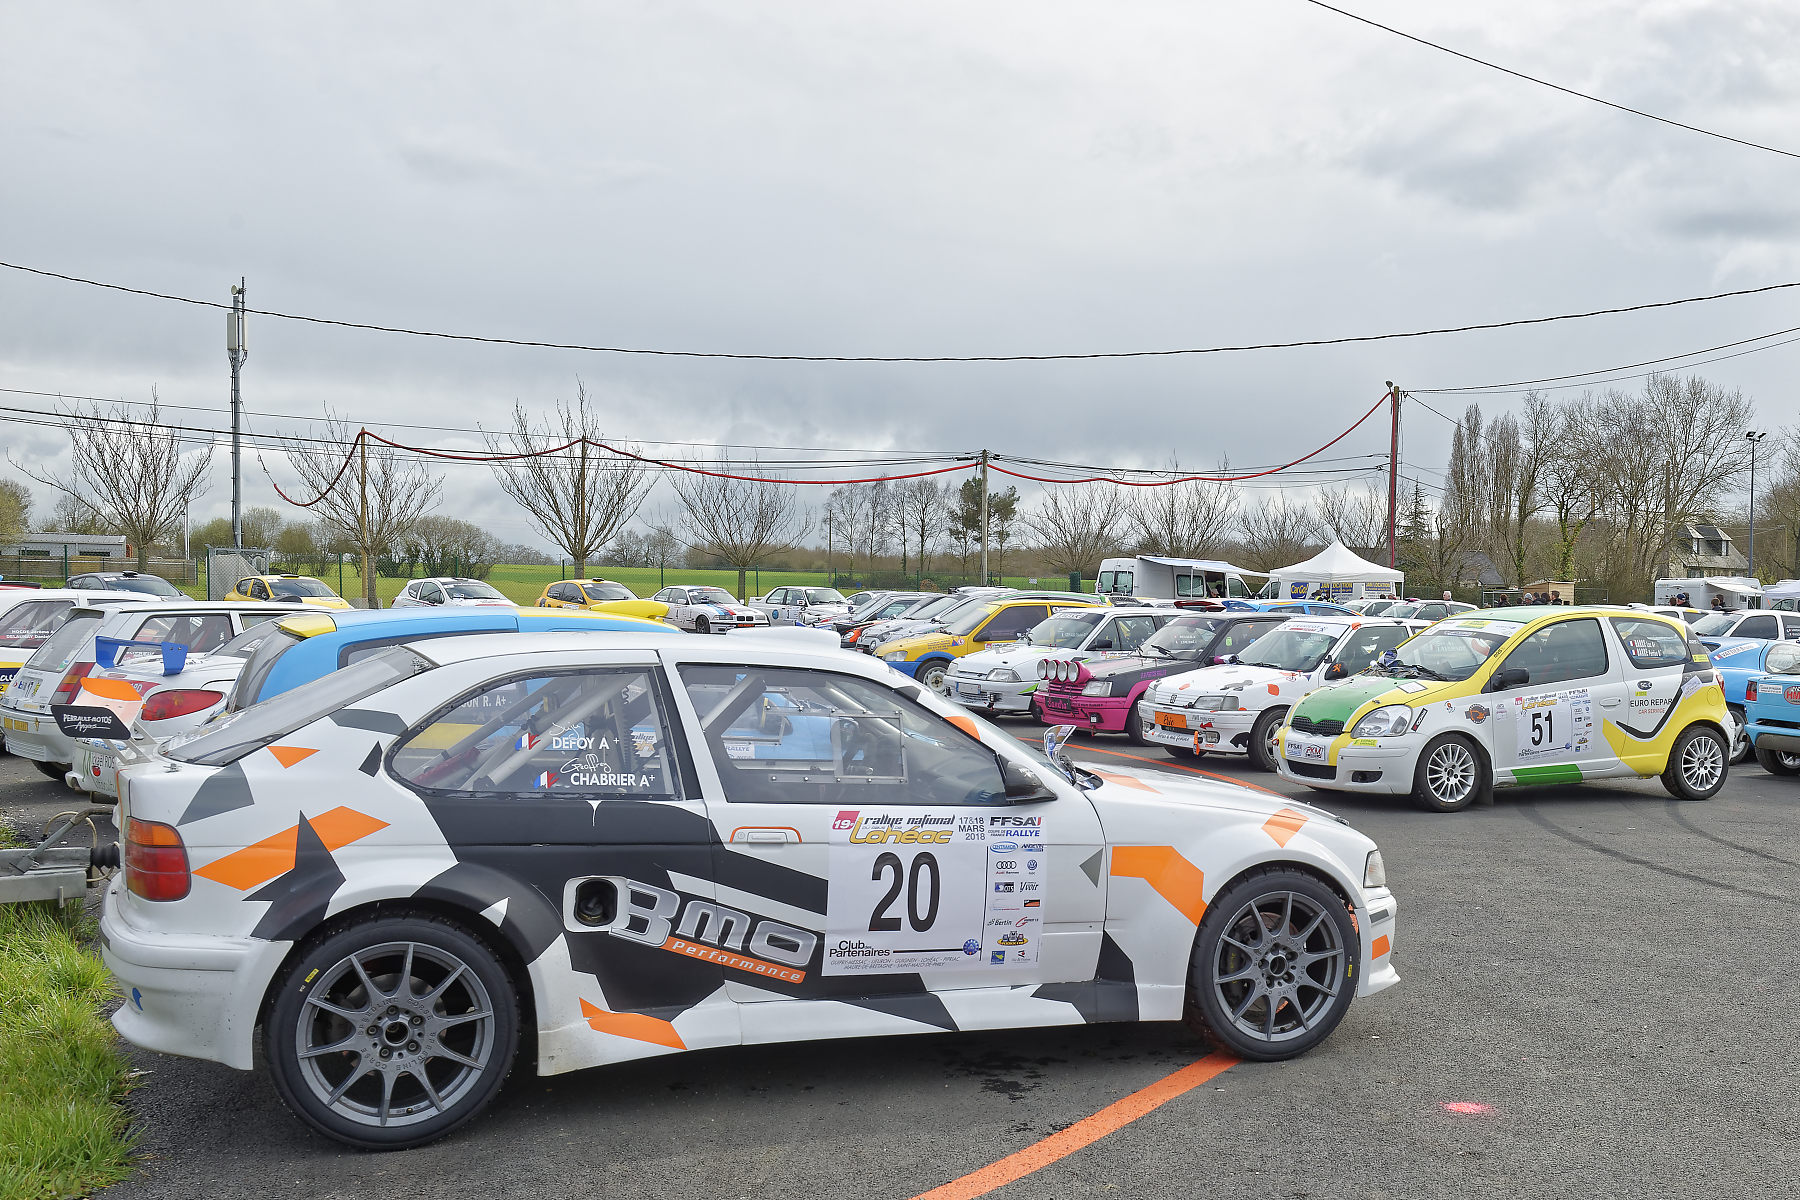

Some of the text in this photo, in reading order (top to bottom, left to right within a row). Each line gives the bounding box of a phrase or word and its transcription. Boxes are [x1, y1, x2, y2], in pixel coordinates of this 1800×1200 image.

[1630, 699, 1650, 708] EURO
[1531, 709, 1553, 747] 51
[552, 736, 595, 750] DEFOY
[570, 772, 637, 786] CHABRIER
[863, 813, 903, 828] rallye
[907, 813, 956, 828] national
[959, 816, 985, 825] 17&18
[989, 816, 1038, 826] FFSA
[850, 817, 954, 845] Lohéac
[958, 825, 985, 833] MARS
[1005, 829, 1041, 837] RALLYE
[965, 832, 986, 841] 2018
[868, 851, 941, 933] 20
[838, 939, 865, 951] Club
[829, 948, 891, 959] Partenaires
[671, 938, 802, 983] Performance
